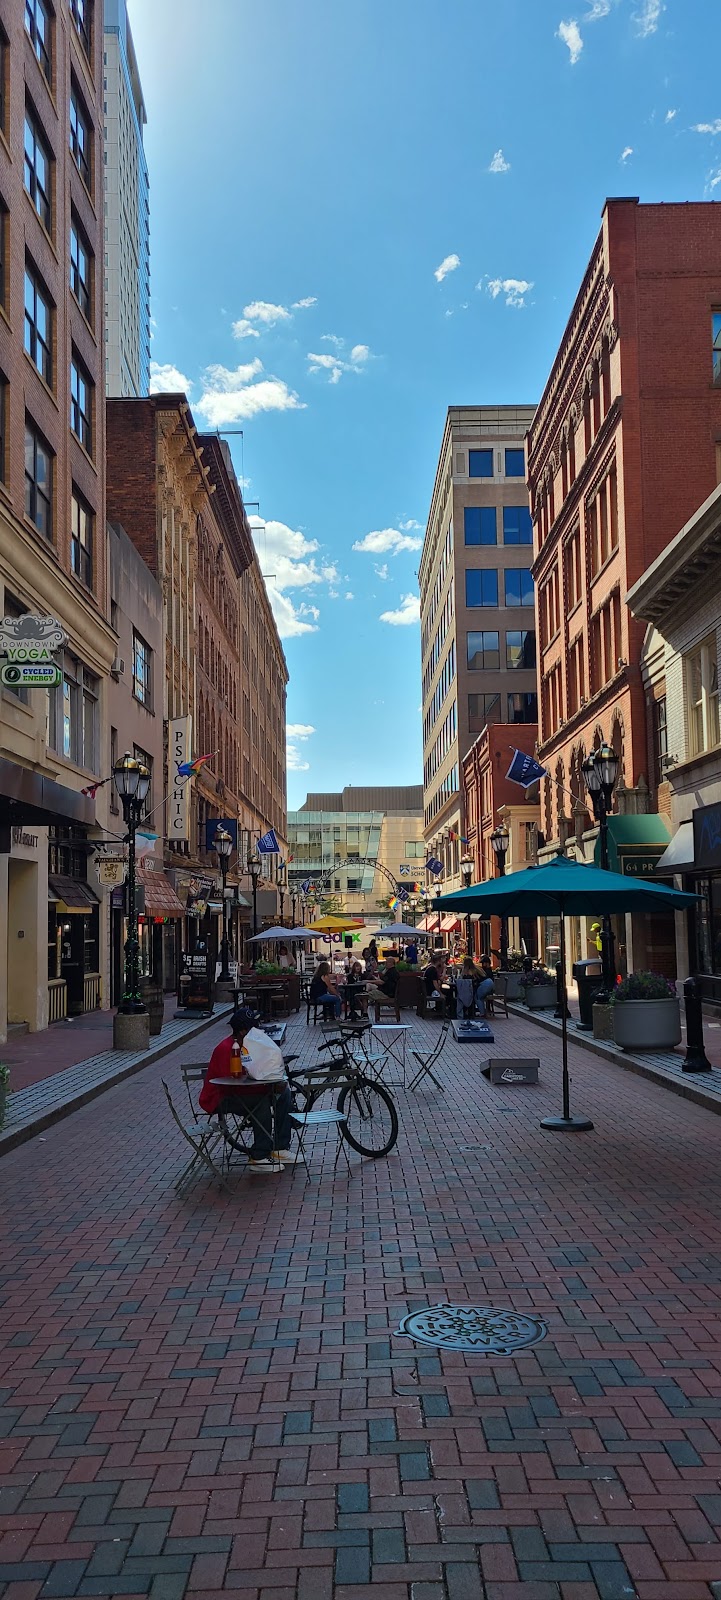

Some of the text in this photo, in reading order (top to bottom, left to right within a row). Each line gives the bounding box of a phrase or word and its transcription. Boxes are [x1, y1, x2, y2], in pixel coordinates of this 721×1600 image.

[9, 648, 49, 659] YOGA
[625, 863, 656, 872] 64 PR
[182, 954, 192, 966] $5
[420, 1330, 530, 1345] SEWER
